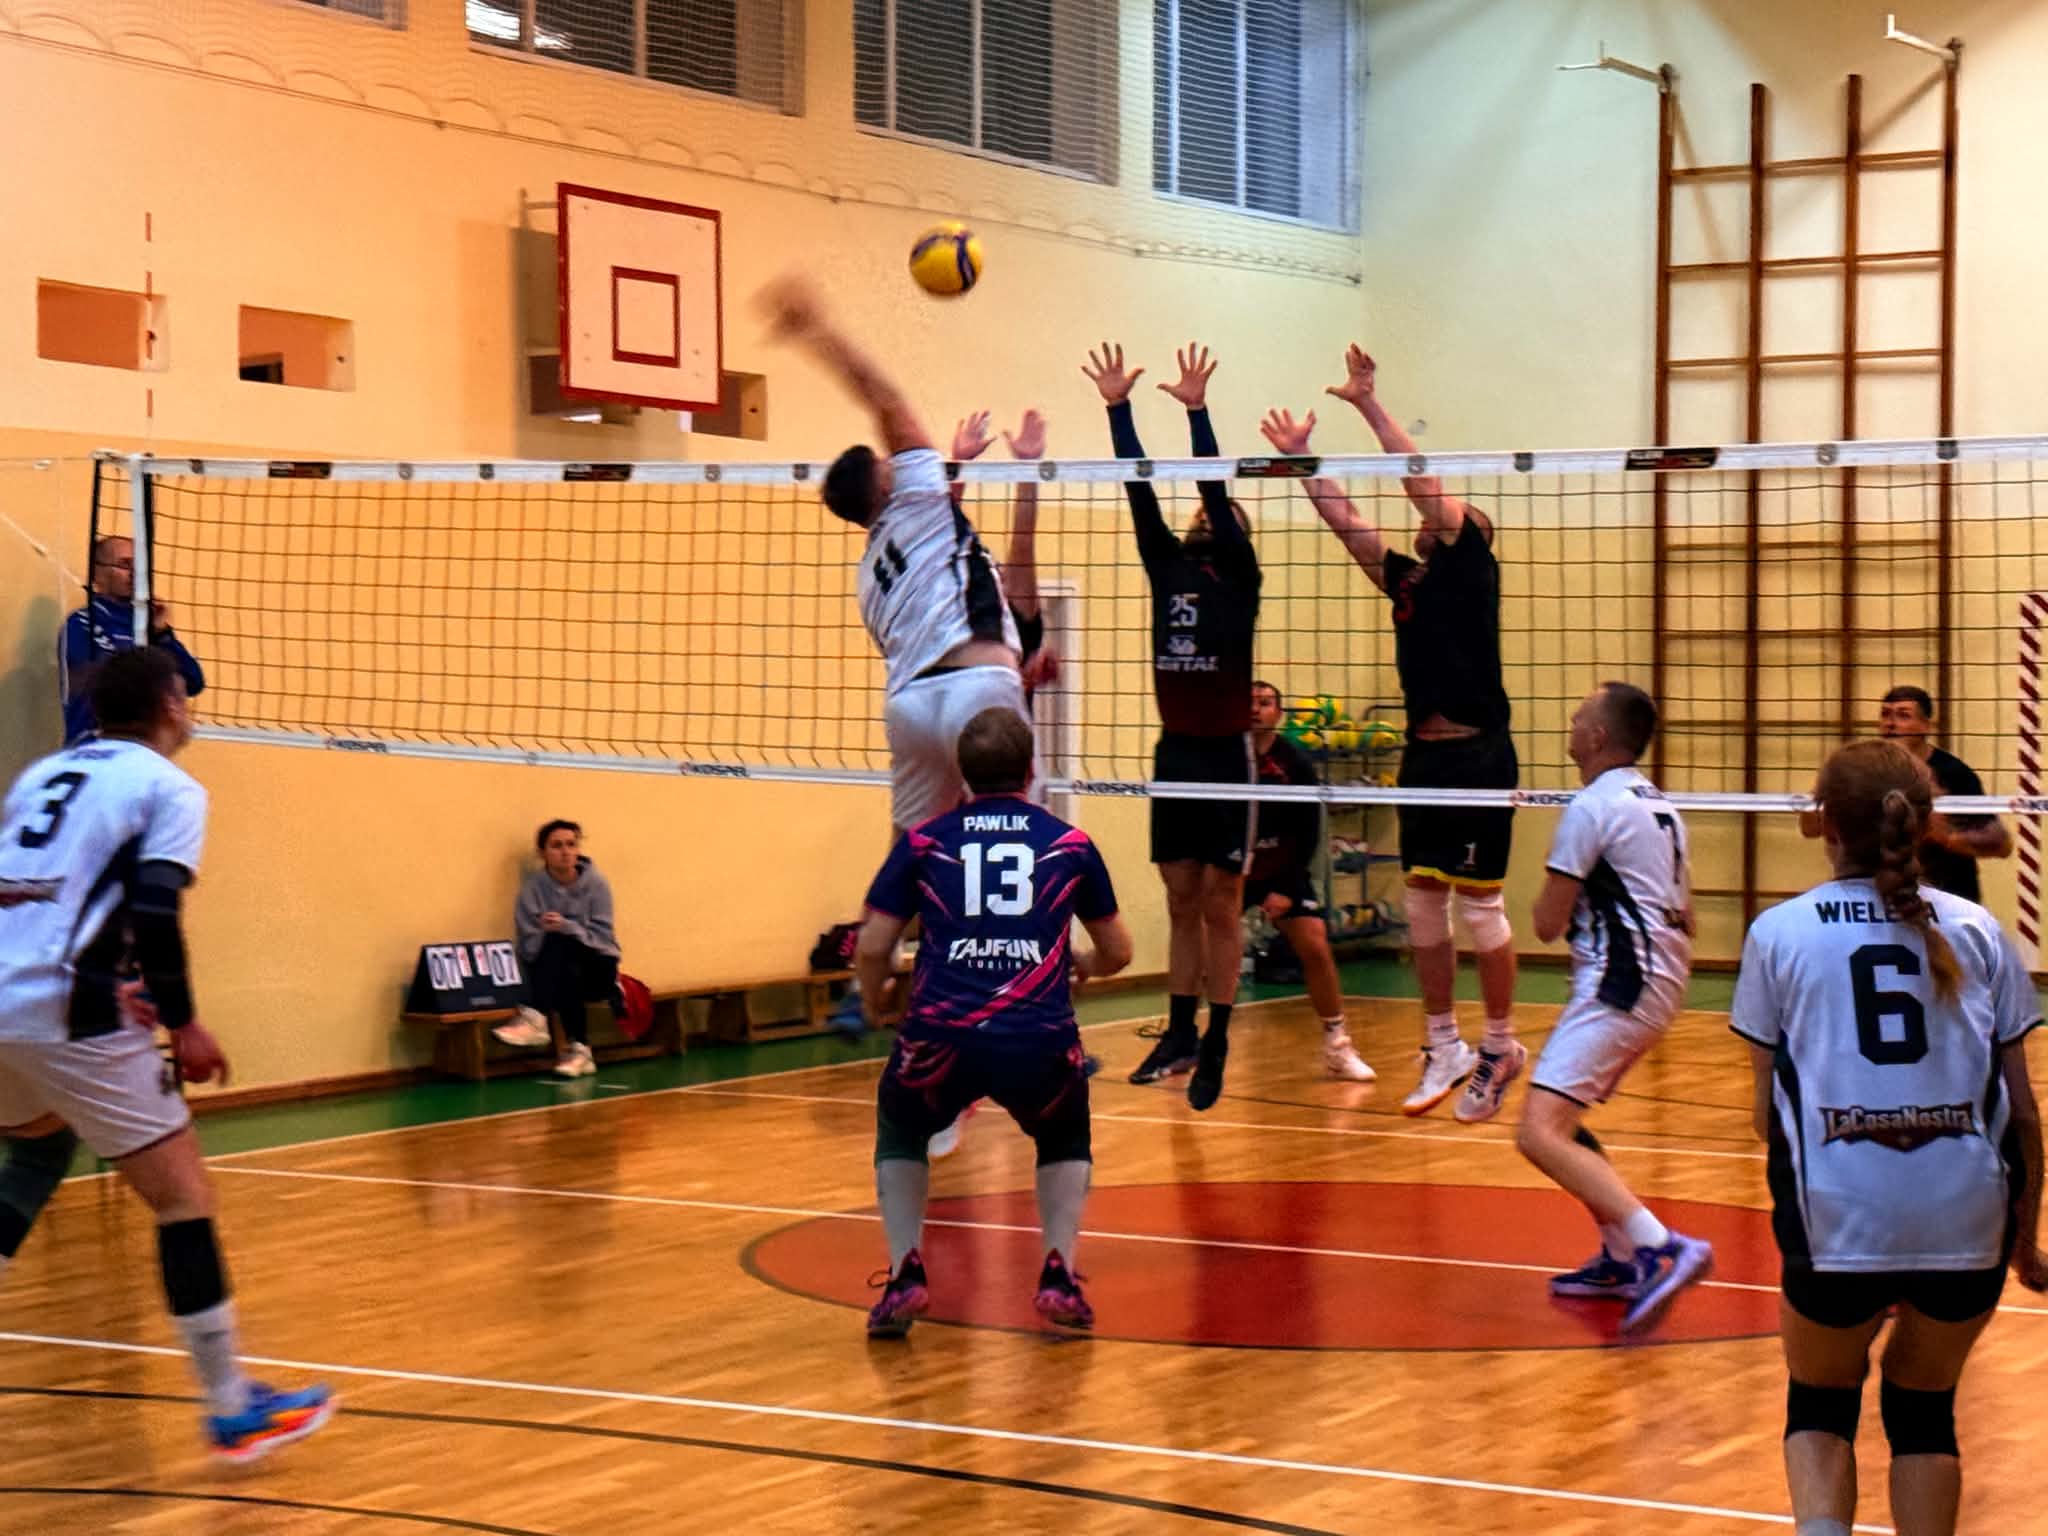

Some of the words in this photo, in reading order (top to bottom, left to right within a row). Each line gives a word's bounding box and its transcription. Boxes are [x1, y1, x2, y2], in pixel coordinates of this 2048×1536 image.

[1168, 593, 1199, 627] 25
[18, 770, 89, 849] 3
[963, 816, 1030, 832] PAWLIK
[1464, 842, 1477, 865] 1
[1654, 812, 1681, 884] 7
[960, 842, 1036, 917] 13
[946, 938, 1043, 964] TAJFUN
[1849, 944, 1929, 1065] 6
